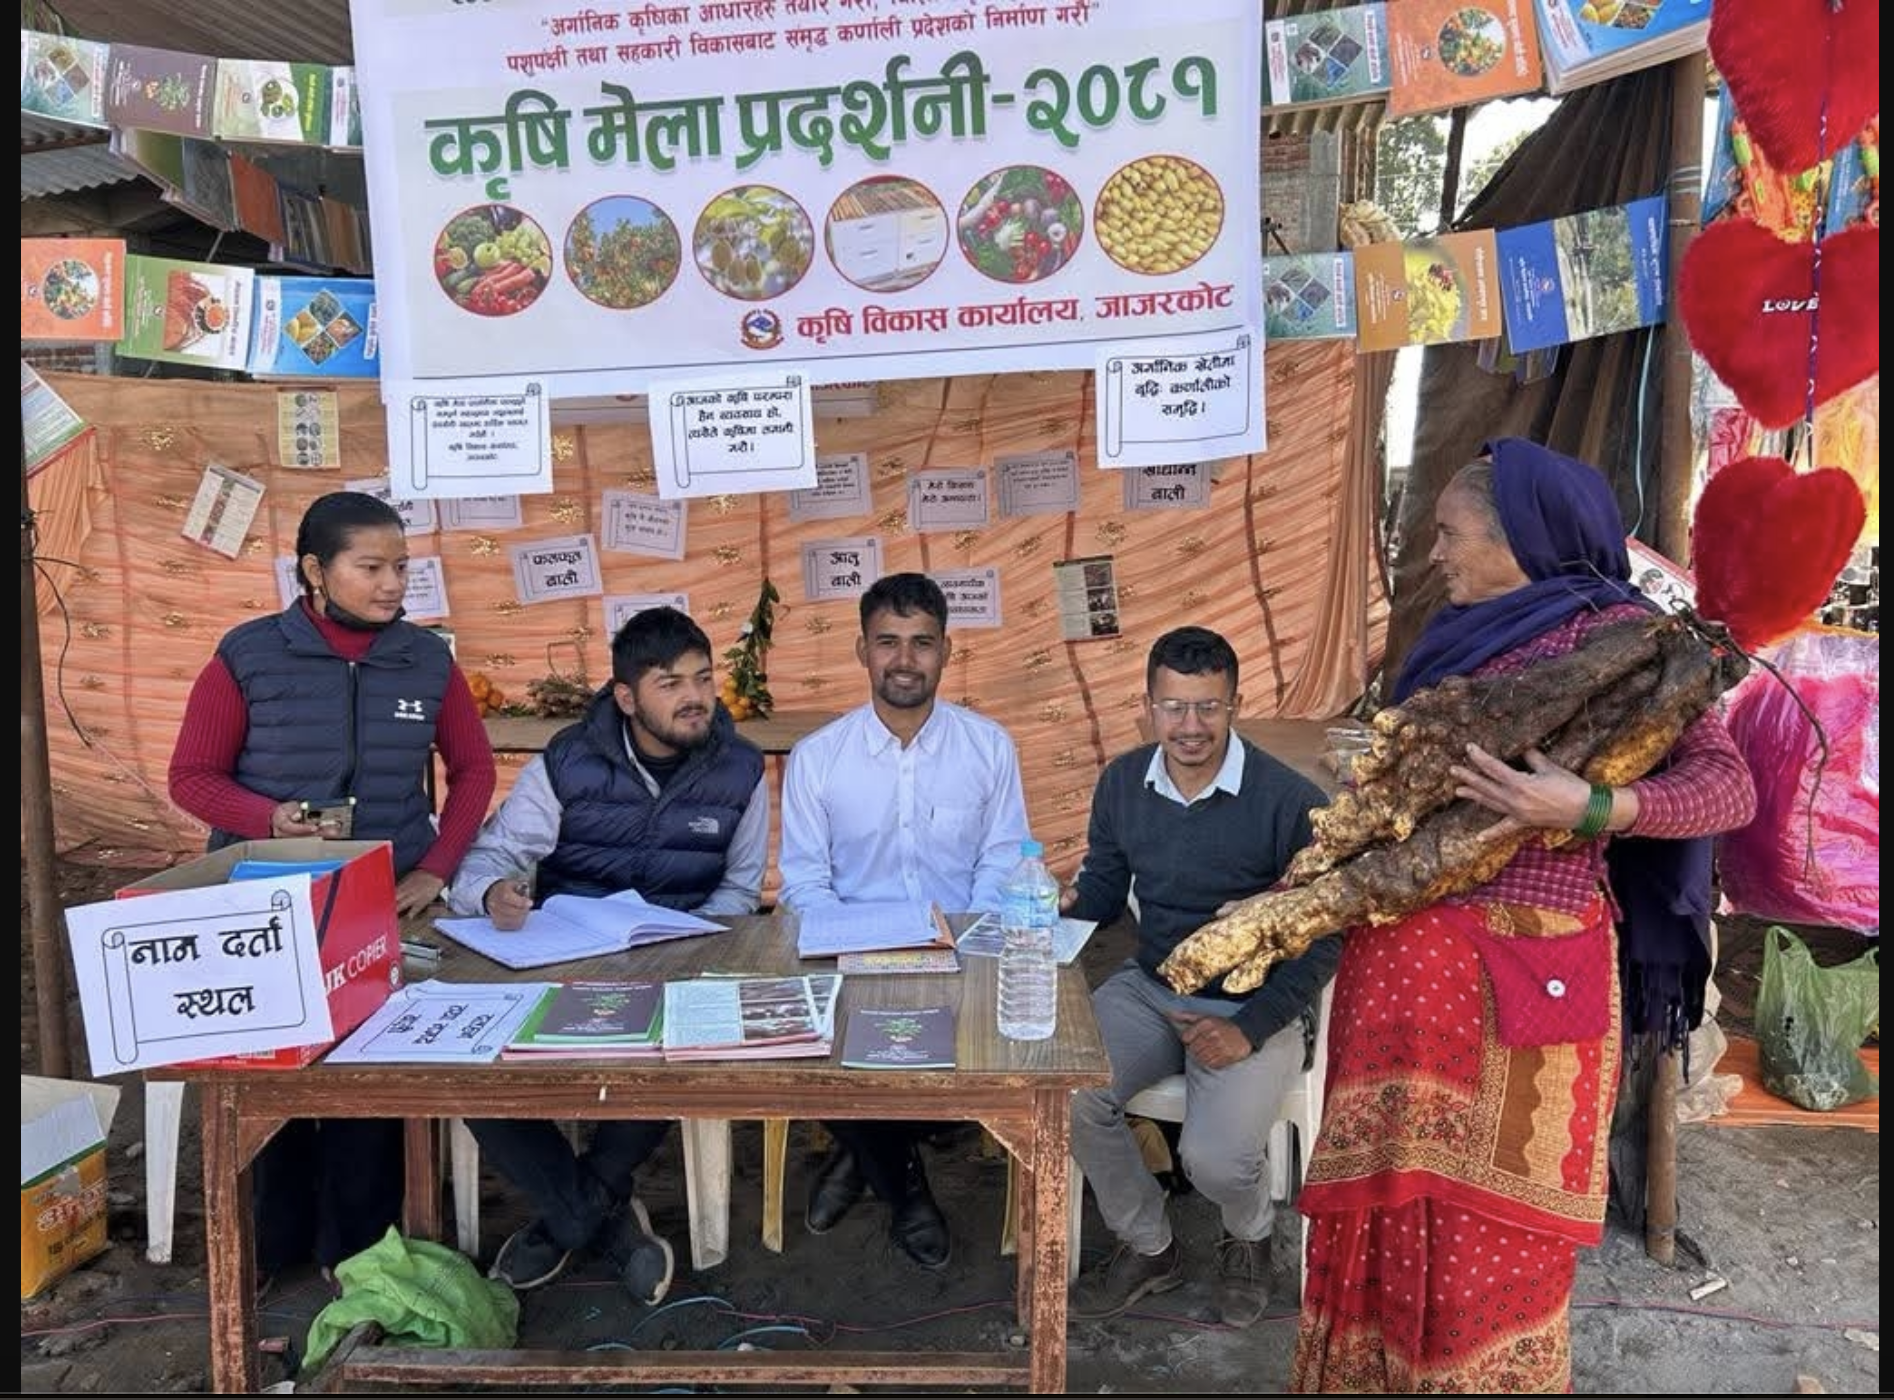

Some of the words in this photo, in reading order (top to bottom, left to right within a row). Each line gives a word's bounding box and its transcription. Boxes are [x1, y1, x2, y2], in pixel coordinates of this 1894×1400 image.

[576, 46, 608, 67] तथा
[617, 35, 682, 65] सहकारी
[690, 31, 777, 57] विकासबाट
[786, 25, 829, 51] समृद्ध
[837, 18, 901, 43] कर्णाली
[912, 9, 975, 38] प्रदेशको
[986, 7, 1046, 30] निर्माण
[628, 3, 690, 35] कृषिका
[424, 88, 572, 201] कृषि
[582, 80, 725, 171] मेला
[797, 307, 853, 344] कृषि
[862, 304, 949, 335] विकास
[1094, 282, 1235, 319] जाजरकोट
[1762, 297, 1820, 313] LOVE
[128, 934, 201, 967] नाम
[218, 916, 284, 958] दर्ता
[347, 934, 388, 978] COPIER
[173, 984, 256, 1020] स्थल
